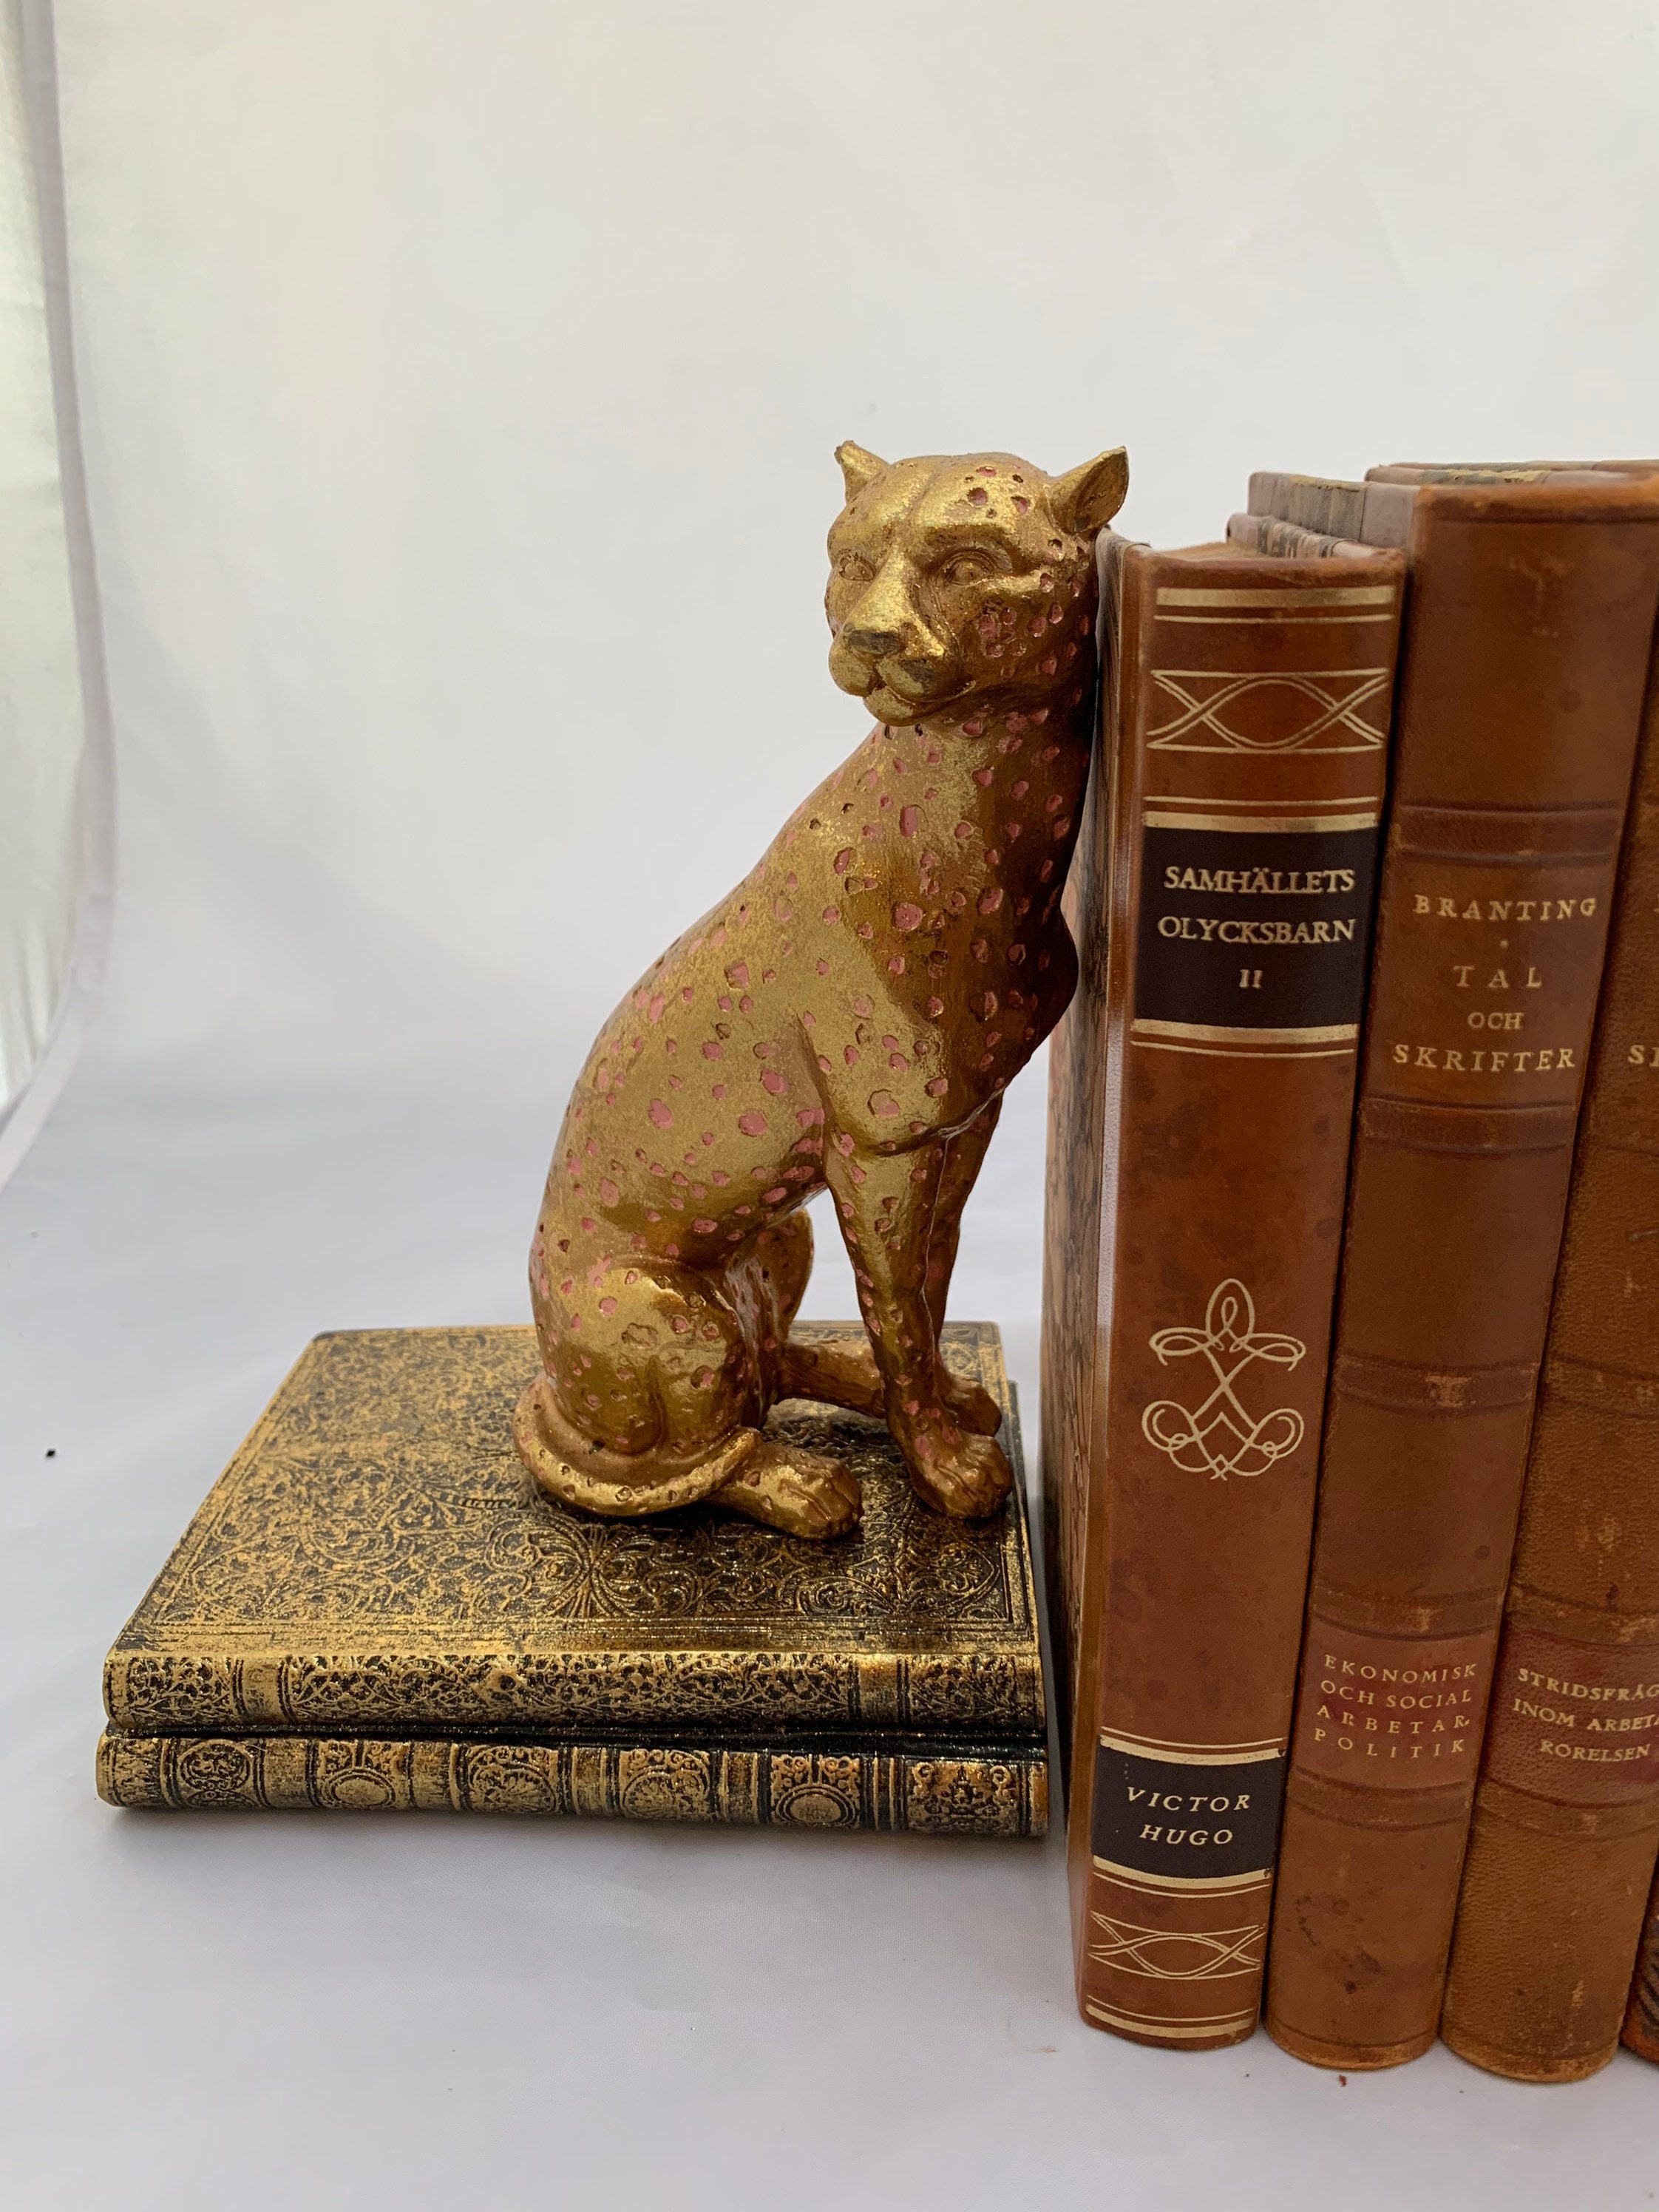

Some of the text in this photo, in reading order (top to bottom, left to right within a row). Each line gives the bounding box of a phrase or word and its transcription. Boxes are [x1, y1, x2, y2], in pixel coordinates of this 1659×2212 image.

[1164, 865, 1356, 894] SAMHÄLLETS
[1413, 894, 1597, 920] BRANTING
[1157, 915, 1357, 944] OLYCKSBARN
[1238, 968, 1263, 989] II
[1467, 1011, 1524, 1030] OCH
[1393, 1044, 1575, 1073] SKRIFTER
[1325, 1654, 1477, 1683] EKONOMISK
[1320, 1680, 1471, 1709] OCH SOCIAL
[1513, 1697, 1575, 1727] INOM
[1314, 1728, 1465, 1759] POLITIK
[1127, 1786, 1251, 1812] VICTOR
[1139, 1824, 1233, 1846] HUGO
